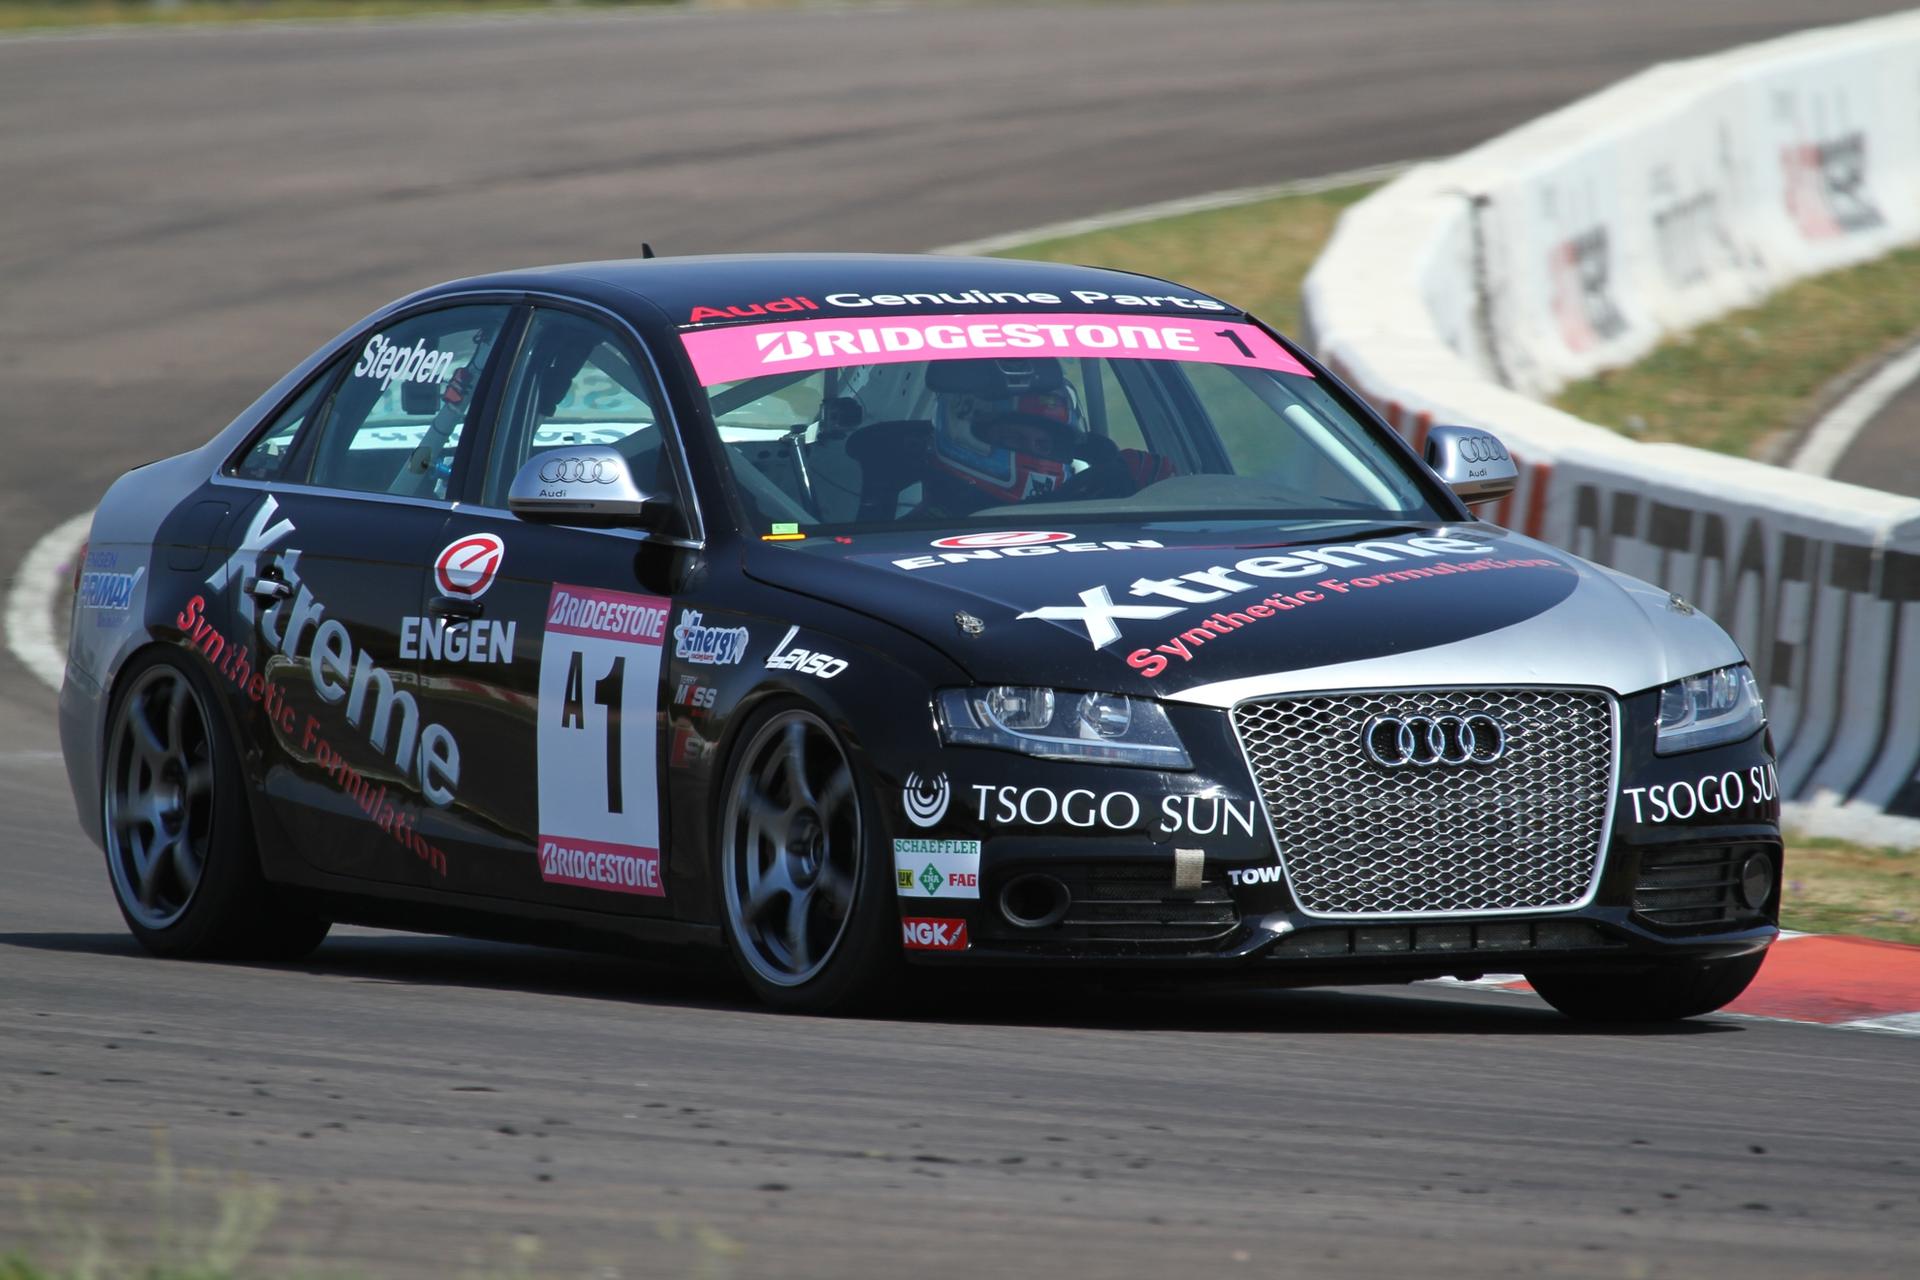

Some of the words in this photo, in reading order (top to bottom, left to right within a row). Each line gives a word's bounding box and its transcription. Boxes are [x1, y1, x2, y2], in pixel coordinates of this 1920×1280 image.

[690, 296, 819, 321] Audi
[825, 290, 1061, 307] Genuine
[1071, 291, 1225, 310] Parts
[354, 333, 454, 391] Stephen
[755, 324, 1200, 364] BRIDGESTONE
[1214, 329, 1256, 359] 1
[538, 489, 567, 498] Audi
[1469, 469, 1488, 478] Audi
[892, 540, 1165, 570] ENGEN
[549, 592, 667, 637] BRIDGESTONE
[1016, 536, 1494, 651] Xtreme
[1126, 591, 1325, 678] Synthetic
[1317, 557, 1561, 594] Formulation
[400, 616, 517, 664] ENGEN
[176, 595, 296, 734] Synthetic
[301, 714, 447, 877] Formulation
[972, 784, 1140, 829] TSOGO
[1159, 795, 1256, 838] SUN
[1623, 771, 1744, 824] TSOGO
[1750, 763, 1779, 804] SUN
[542, 842, 658, 888] BRIDGESTONE
[895, 840, 978, 854] SCHAEFFLER
[949, 874, 976, 887] FAG
[1228, 866, 1282, 885] TOW
[902, 922, 950, 946] NGK
